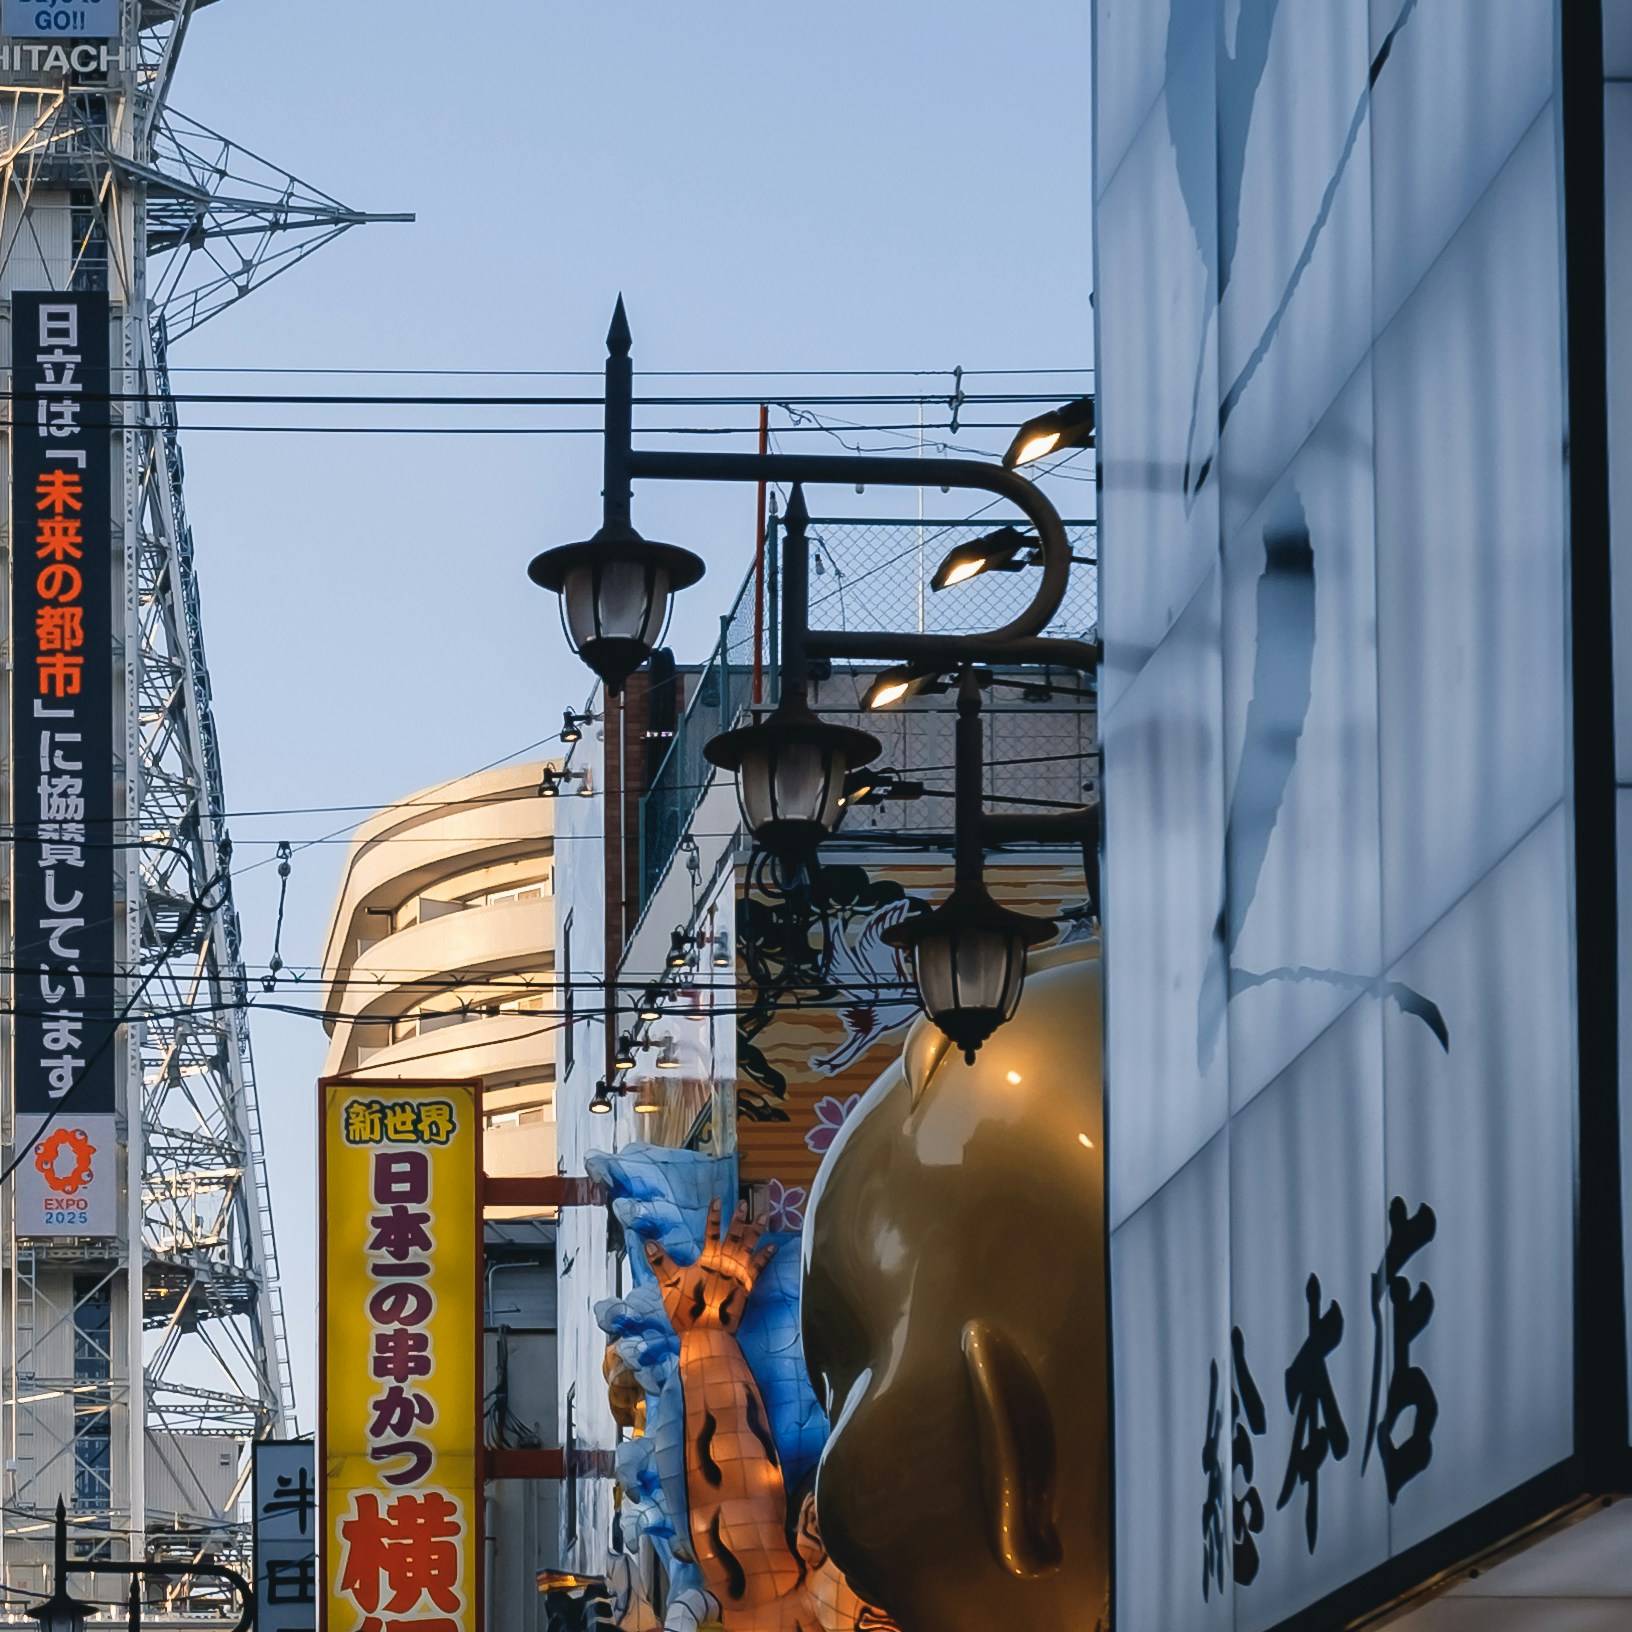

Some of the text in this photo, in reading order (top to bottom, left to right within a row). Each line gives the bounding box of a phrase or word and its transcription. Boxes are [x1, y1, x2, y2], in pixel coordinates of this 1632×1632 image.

[34, 10, 85, 31] GO!!
[34, 303, 87, 1099] 日立は「未来の都市」に協賛しています
[345, 1101, 456, 1145] 新世界
[44, 1199, 89, 1211] EXPO
[44, 1212, 89, 1226] 2025
[368, 1151, 435, 1486] 日本一の串かつ
[1202, 1195, 1438, 1603] 総本店
